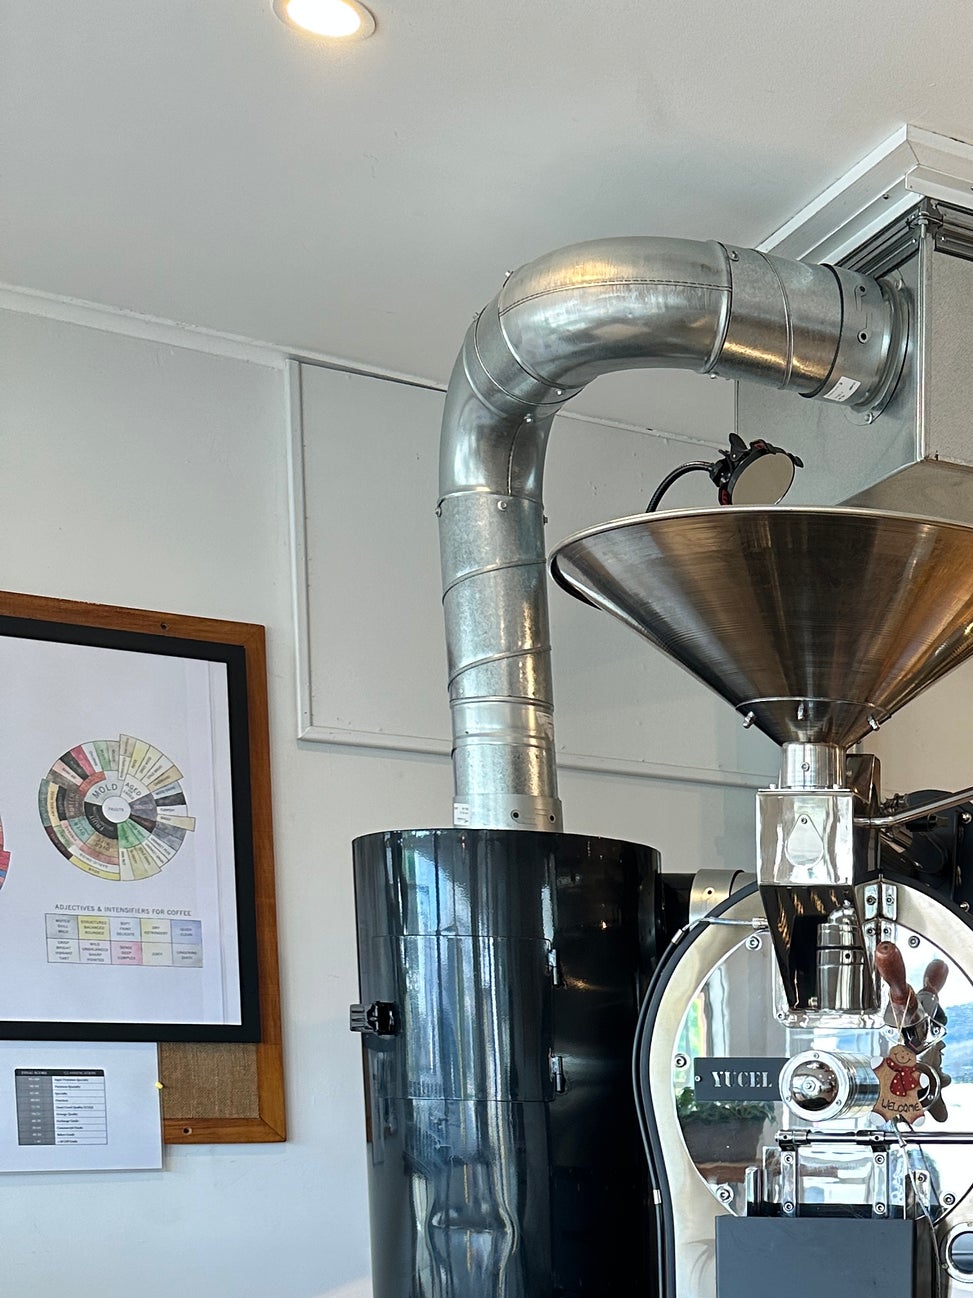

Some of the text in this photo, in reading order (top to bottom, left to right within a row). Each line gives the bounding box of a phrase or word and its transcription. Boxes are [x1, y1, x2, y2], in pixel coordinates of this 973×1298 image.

[92, 783, 118, 799] MOLD
[125, 782, 141, 797] AGED
[55, 903, 95, 912] ADJECTIVES
[104, 906, 150, 915] INTENSIFIERS
[152, 908, 165, 916] FOR
[167, 909, 192, 917] COFFEE
[881, 1099, 923, 1114] WELCOME
